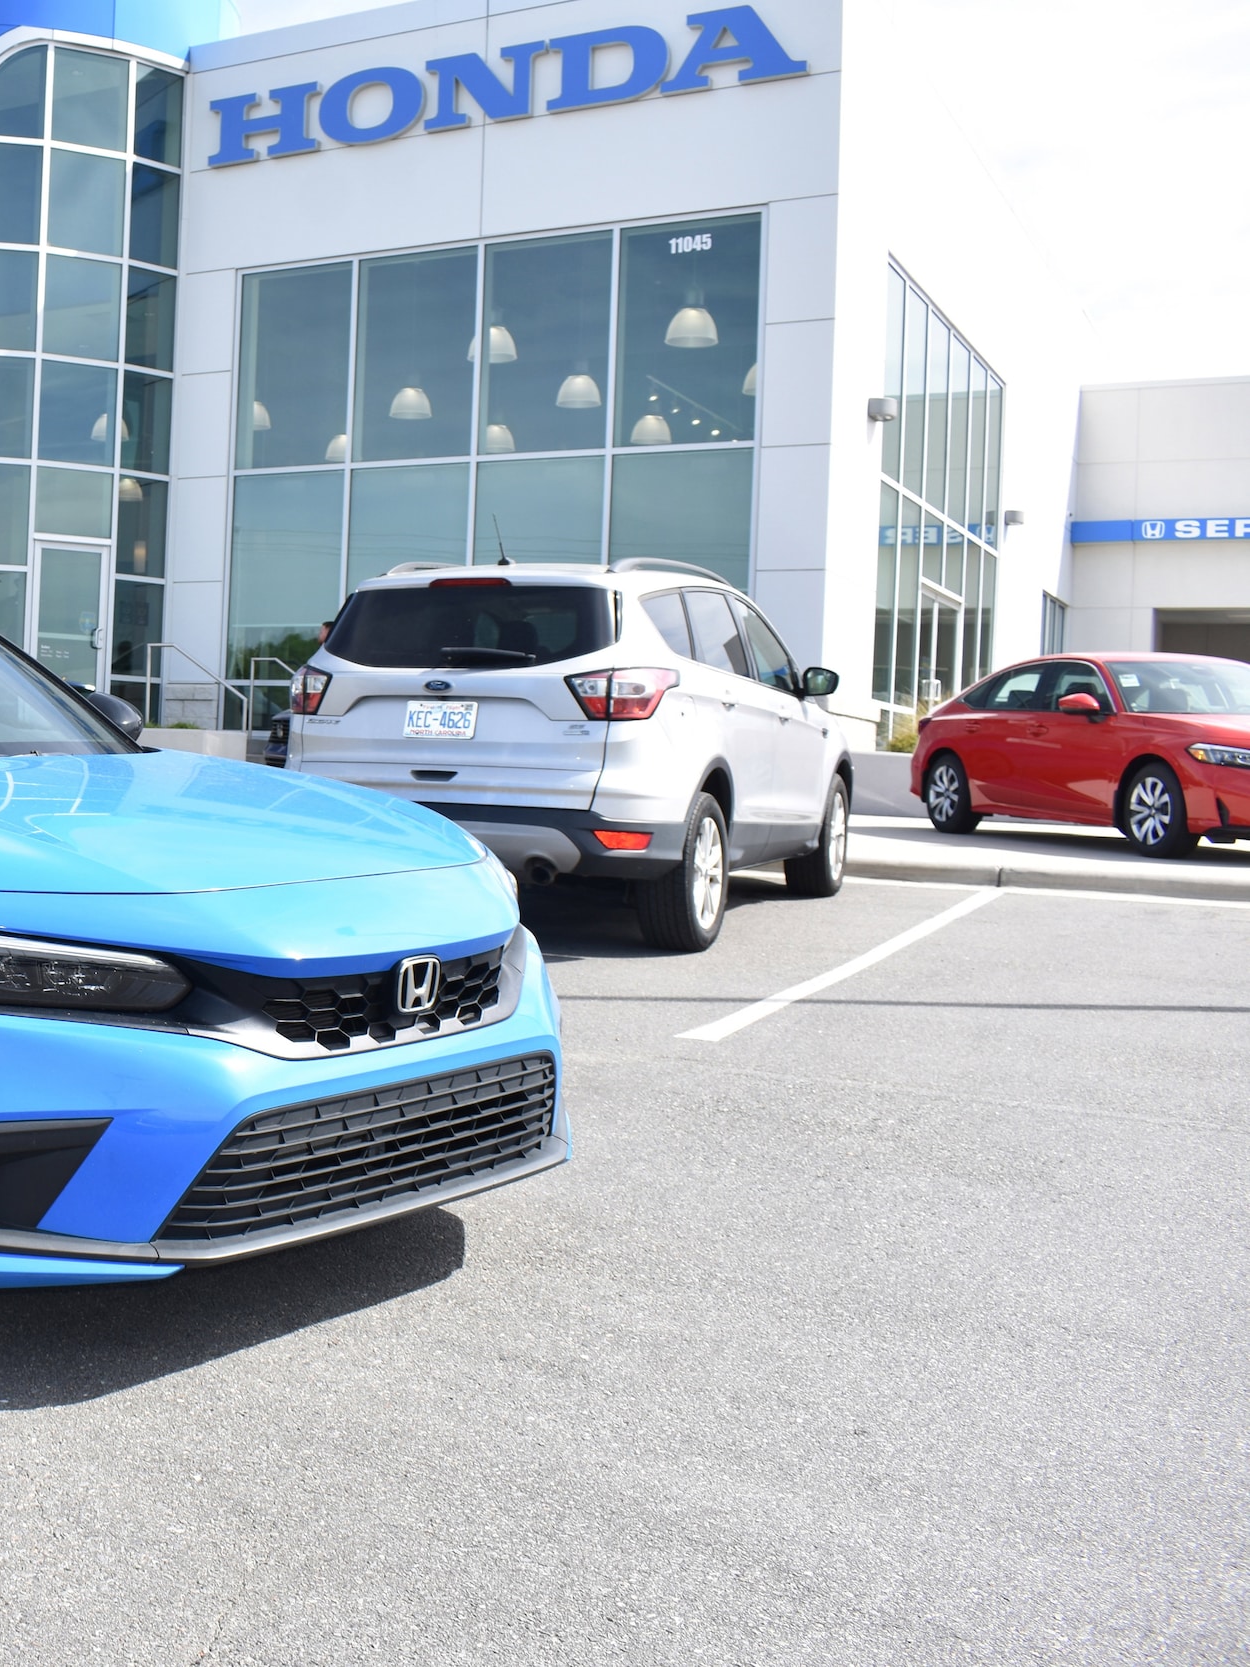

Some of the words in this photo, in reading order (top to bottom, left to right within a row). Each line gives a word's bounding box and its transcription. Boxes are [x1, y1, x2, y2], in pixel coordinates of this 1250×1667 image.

[208, 4, 809, 168] HONDA
[668, 233, 712, 254] 11045
[407, 710, 472, 729] KEC-4626
